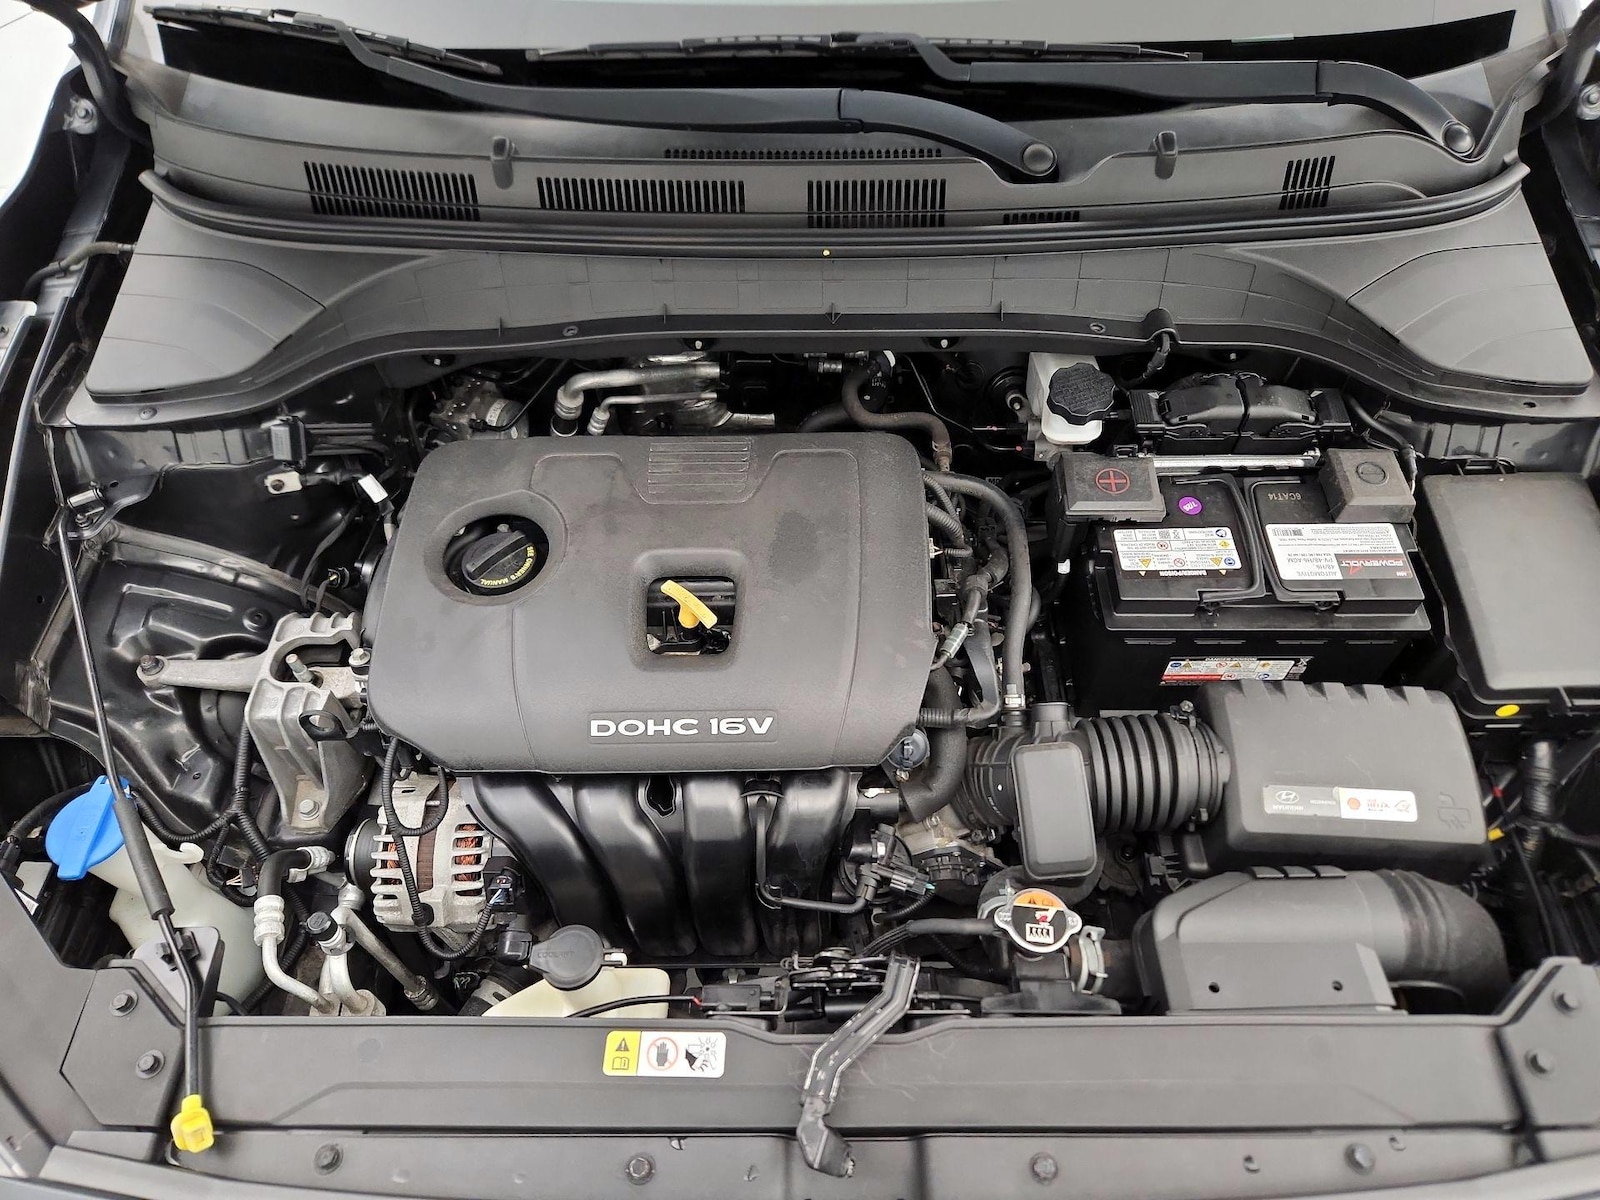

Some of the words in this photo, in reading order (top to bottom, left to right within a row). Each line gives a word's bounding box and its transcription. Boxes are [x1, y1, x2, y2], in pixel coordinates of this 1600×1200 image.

[1267, 492, 1302, 500] 6CAT14
[526, 546, 535, 557] SEE
[510, 557, 533, 580] OWNER'S
[1339, 559, 1404, 568] POWERVOLT
[480, 577, 509, 587] MANUAL
[590, 718, 699, 737] DOHC
[709, 716, 774, 736] 16V
